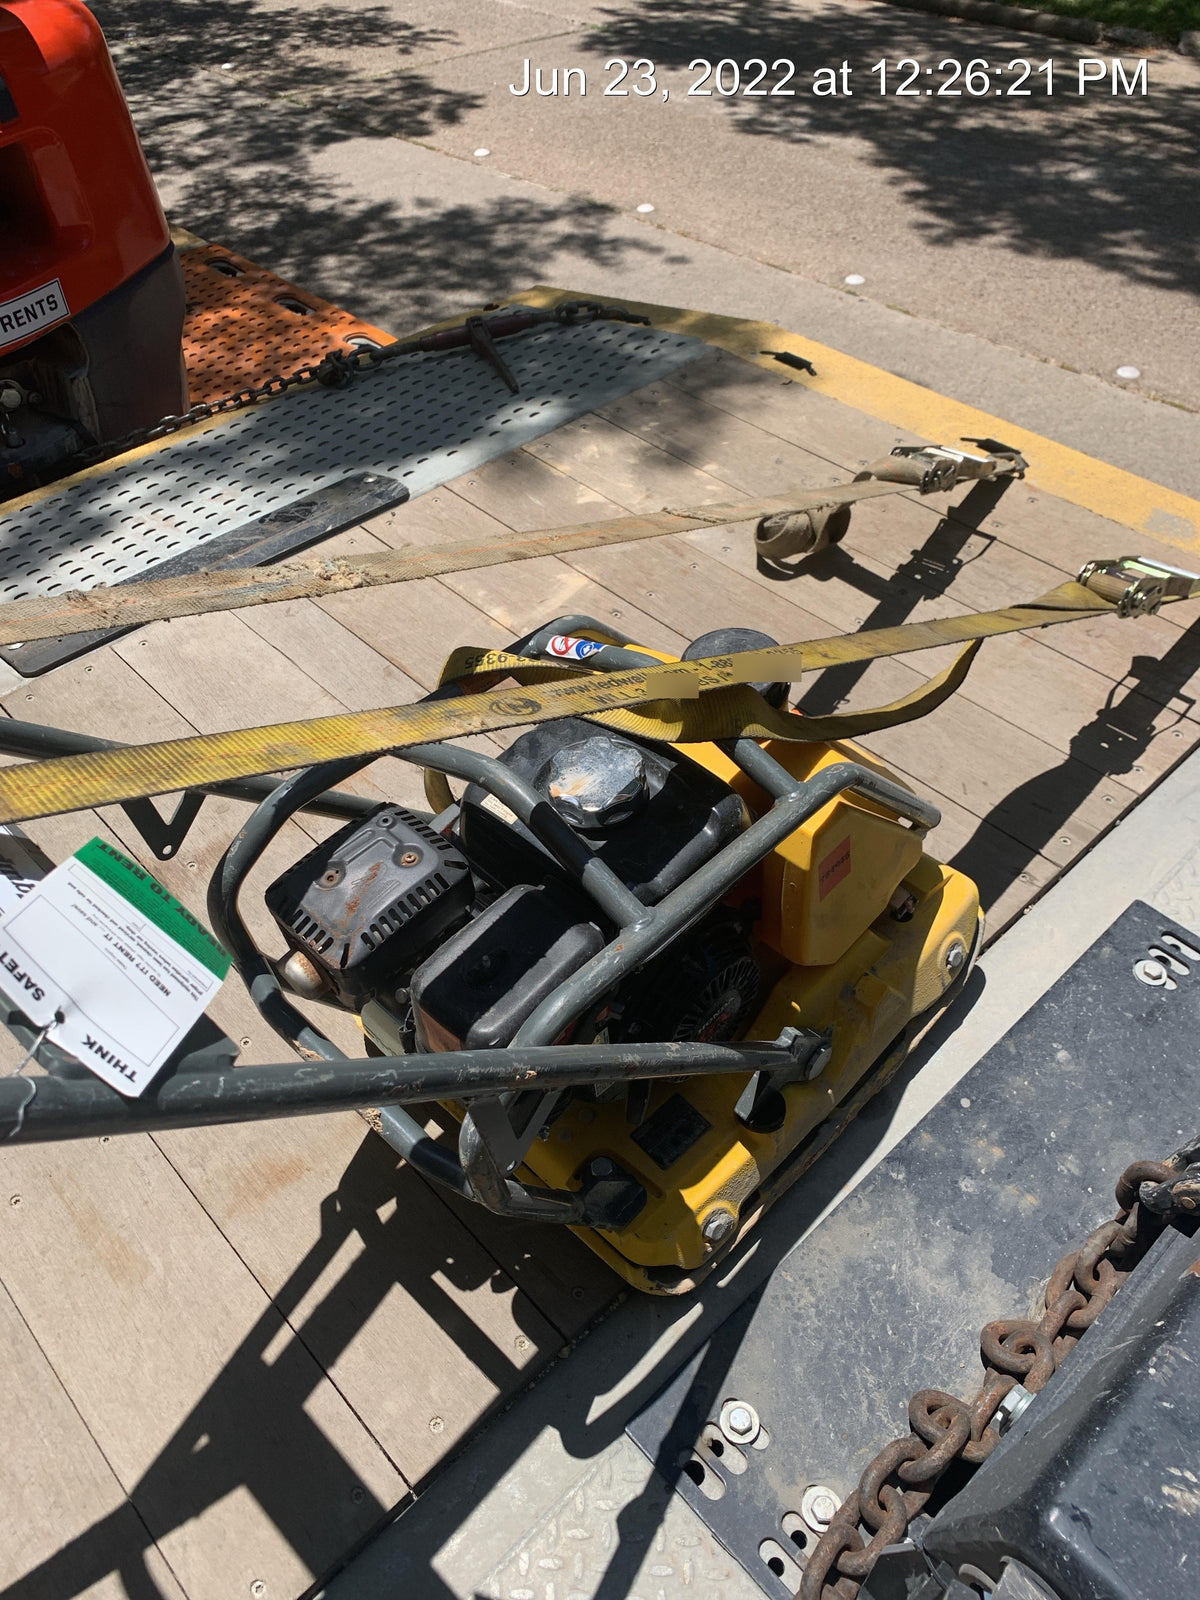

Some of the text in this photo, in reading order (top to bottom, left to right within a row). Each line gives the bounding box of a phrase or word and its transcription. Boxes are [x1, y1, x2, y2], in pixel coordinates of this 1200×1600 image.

[0, 294, 58, 333] RENTS
[96, 843, 147, 881] RENT
[149, 882, 172, 905] TO
[113, 942, 136, 963] RENT
[135, 962, 149, 976] IT?
[149, 974, 171, 997] NEED
[81, 1033, 138, 1083] THINK
